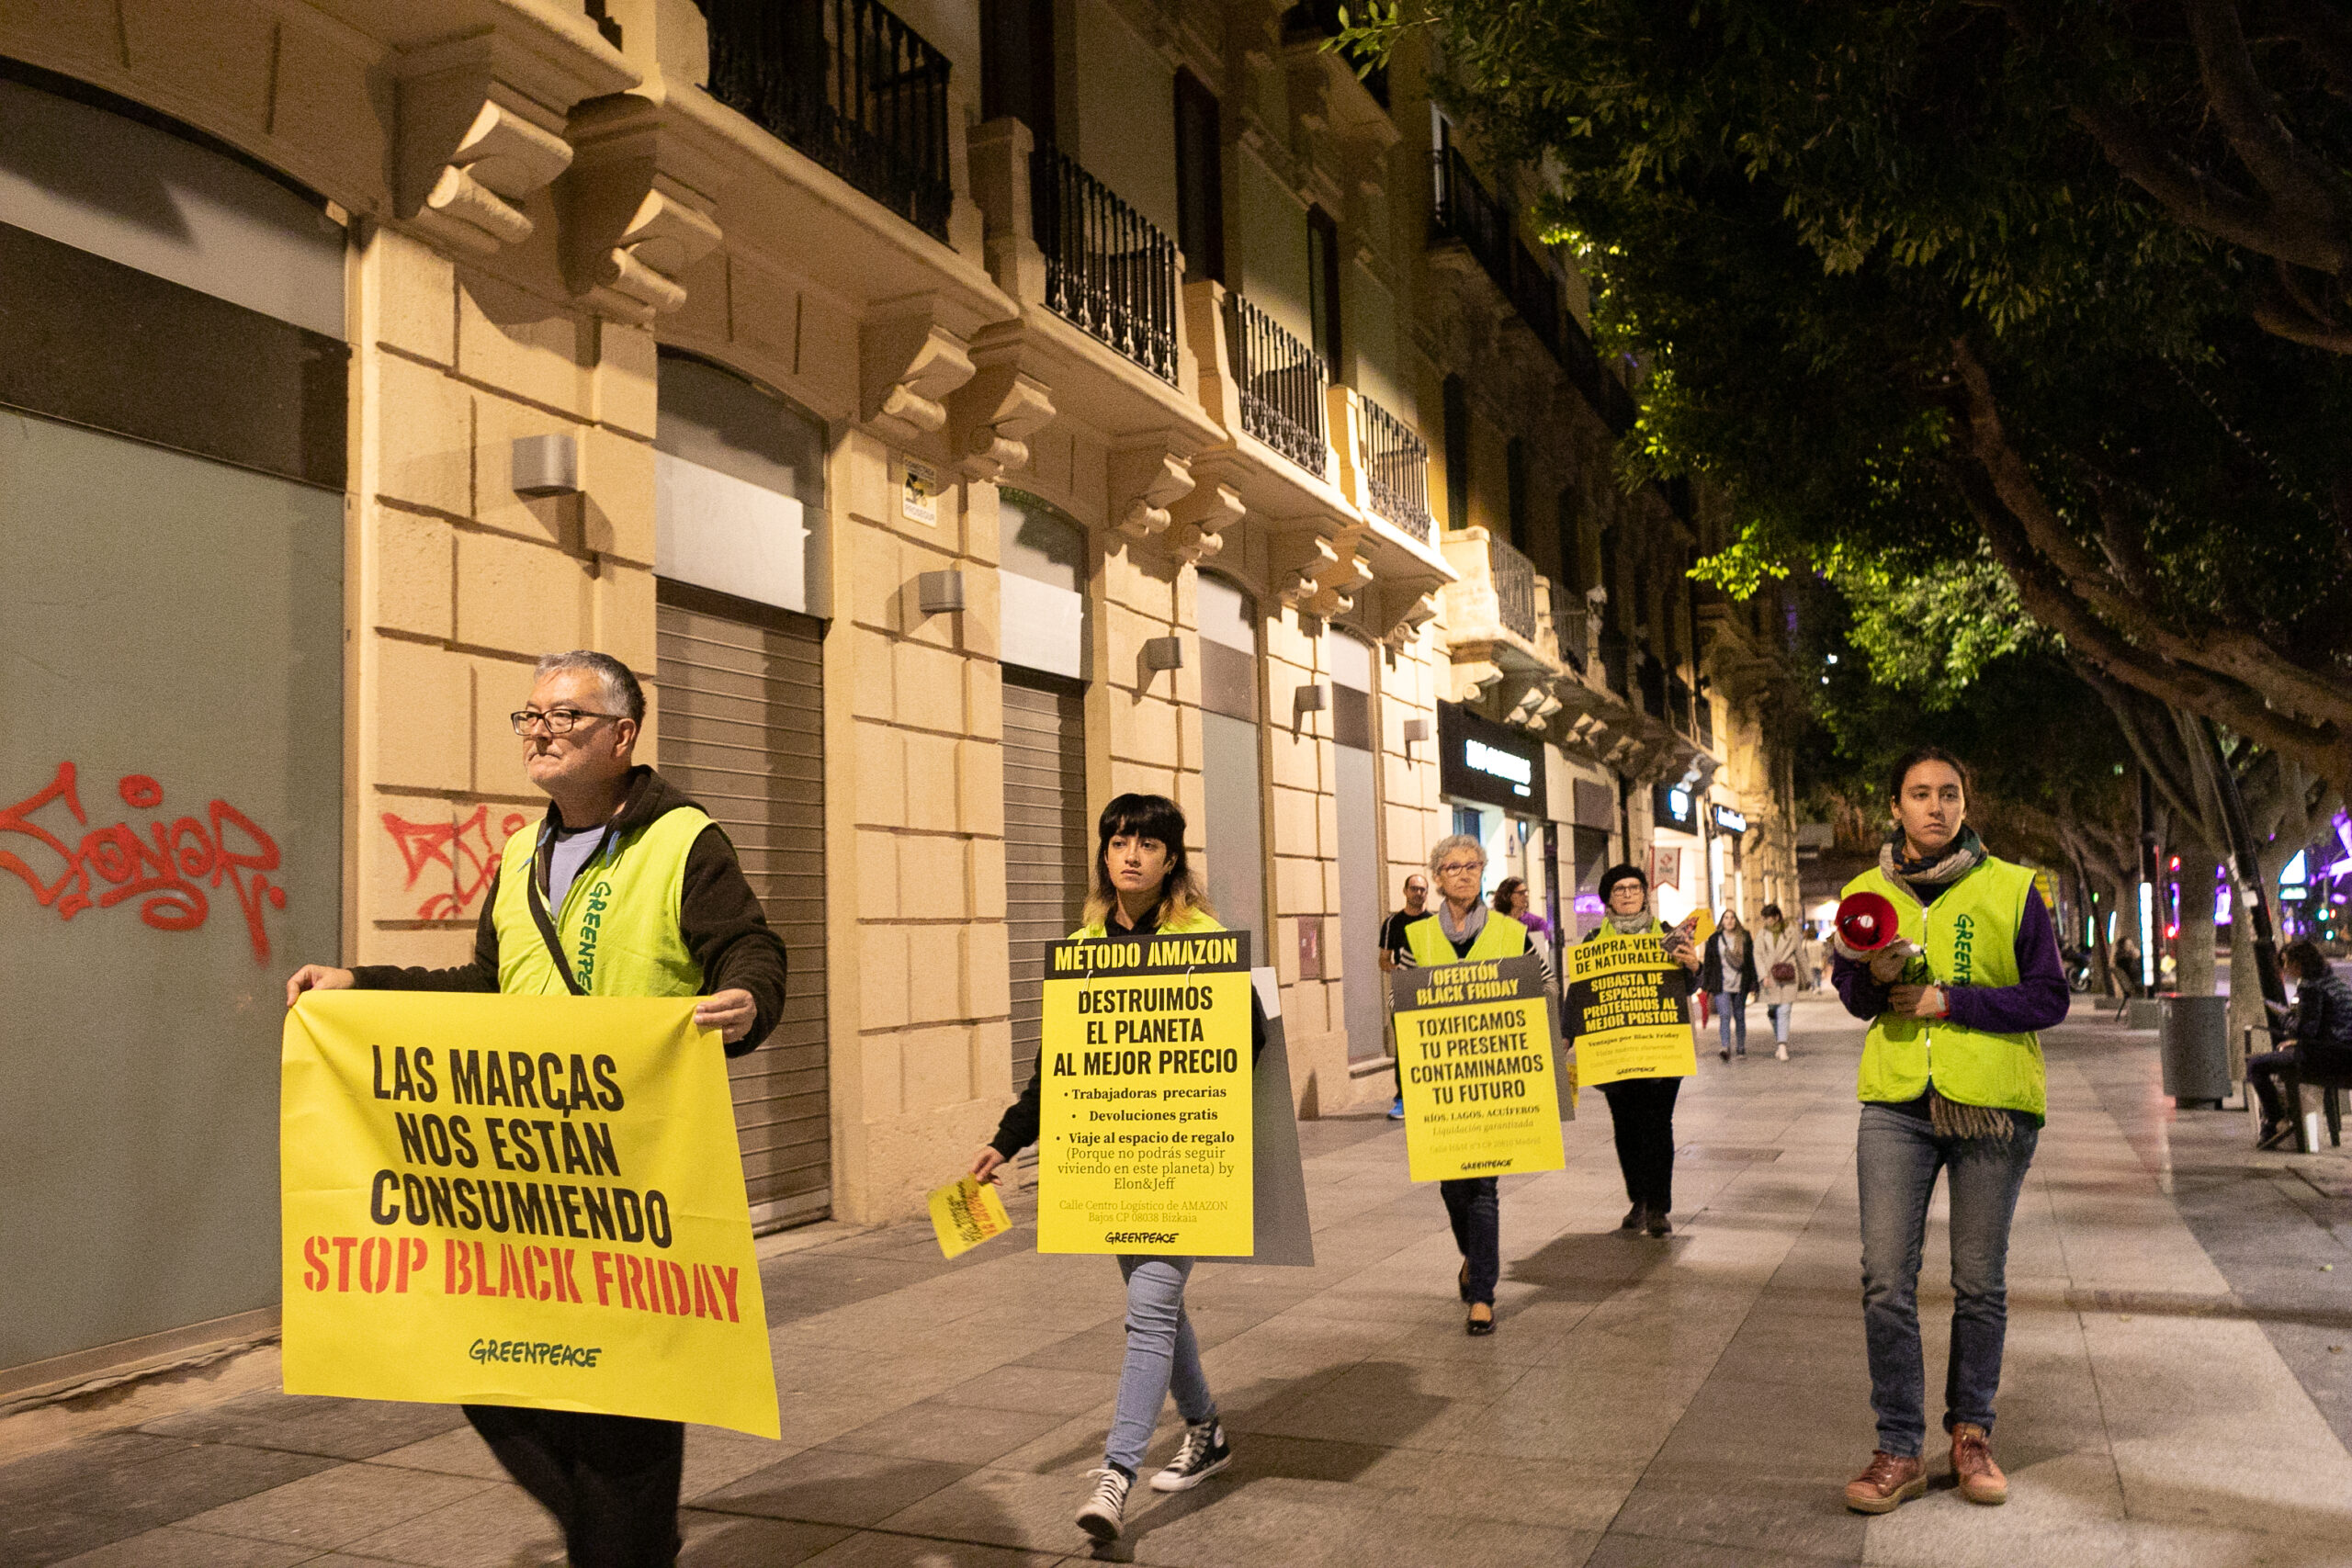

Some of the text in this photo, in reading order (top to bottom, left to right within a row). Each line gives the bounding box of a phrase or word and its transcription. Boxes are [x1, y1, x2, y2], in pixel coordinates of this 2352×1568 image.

[1054, 938, 1238, 971] MÉTODO AMAZON
[1432, 960, 1499, 987] OFERTÓN
[1576, 961, 1591, 975] DE
[1416, 977, 1520, 1007] BLACK FRIDAY
[1590, 972, 1664, 992] SUBASTA DE
[1078, 986, 1214, 1015] DESTRUIMOS
[1599, 986, 1658, 1004] ESPACIOS
[1583, 997, 1679, 1021] PROTEGIDOS AL
[1585, 1010, 1679, 1032] MEJOR POSTOR
[1086, 1018, 1204, 1045] EL PLANETA
[1417, 1010, 1527, 1038] TOXIFICAMOS
[1419, 1032, 1529, 1060] TU PRESENTE
[1053, 1048, 1238, 1077] AL MEJOR PRECIO
[1410, 1054, 1544, 1085] CONTAMINAMOS
[372, 1044, 625, 1112] LAS MARCAS
[1071, 1086, 1227, 1102] Trabajadoras precarias
[1431, 1079, 1526, 1105] TU FUTURO
[1089, 1108, 1218, 1123] Devoluciones gratis
[394, 1102, 622, 1178] NOS ESTÁN
[1069, 1131, 1235, 1146] Viaje al espacio de regalo
[1066, 1146, 1226, 1162] (Porque no podrás seguir
[1460, 1158, 1513, 1171] GREENPEACE
[1057, 1161, 1235, 1178] viviendo en este planeta) by
[1114, 1177, 1176, 1191] Elon&Jeff
[369, 1169, 673, 1248] CONSUMIENDO
[1058, 1200, 1228, 1213] Calle Centro Logístico de AMAZON
[1088, 1213, 1114, 1224] Bajos
[1115, 1213, 1130, 1223] CP
[1161, 1213, 1198, 1224] Bizkaia
[1104, 1231, 1180, 1245] GREENPEACE
[303, 1235, 741, 1324] STOP BLACK FRIDAY
[469, 1337, 602, 1369] GREENPEACE
